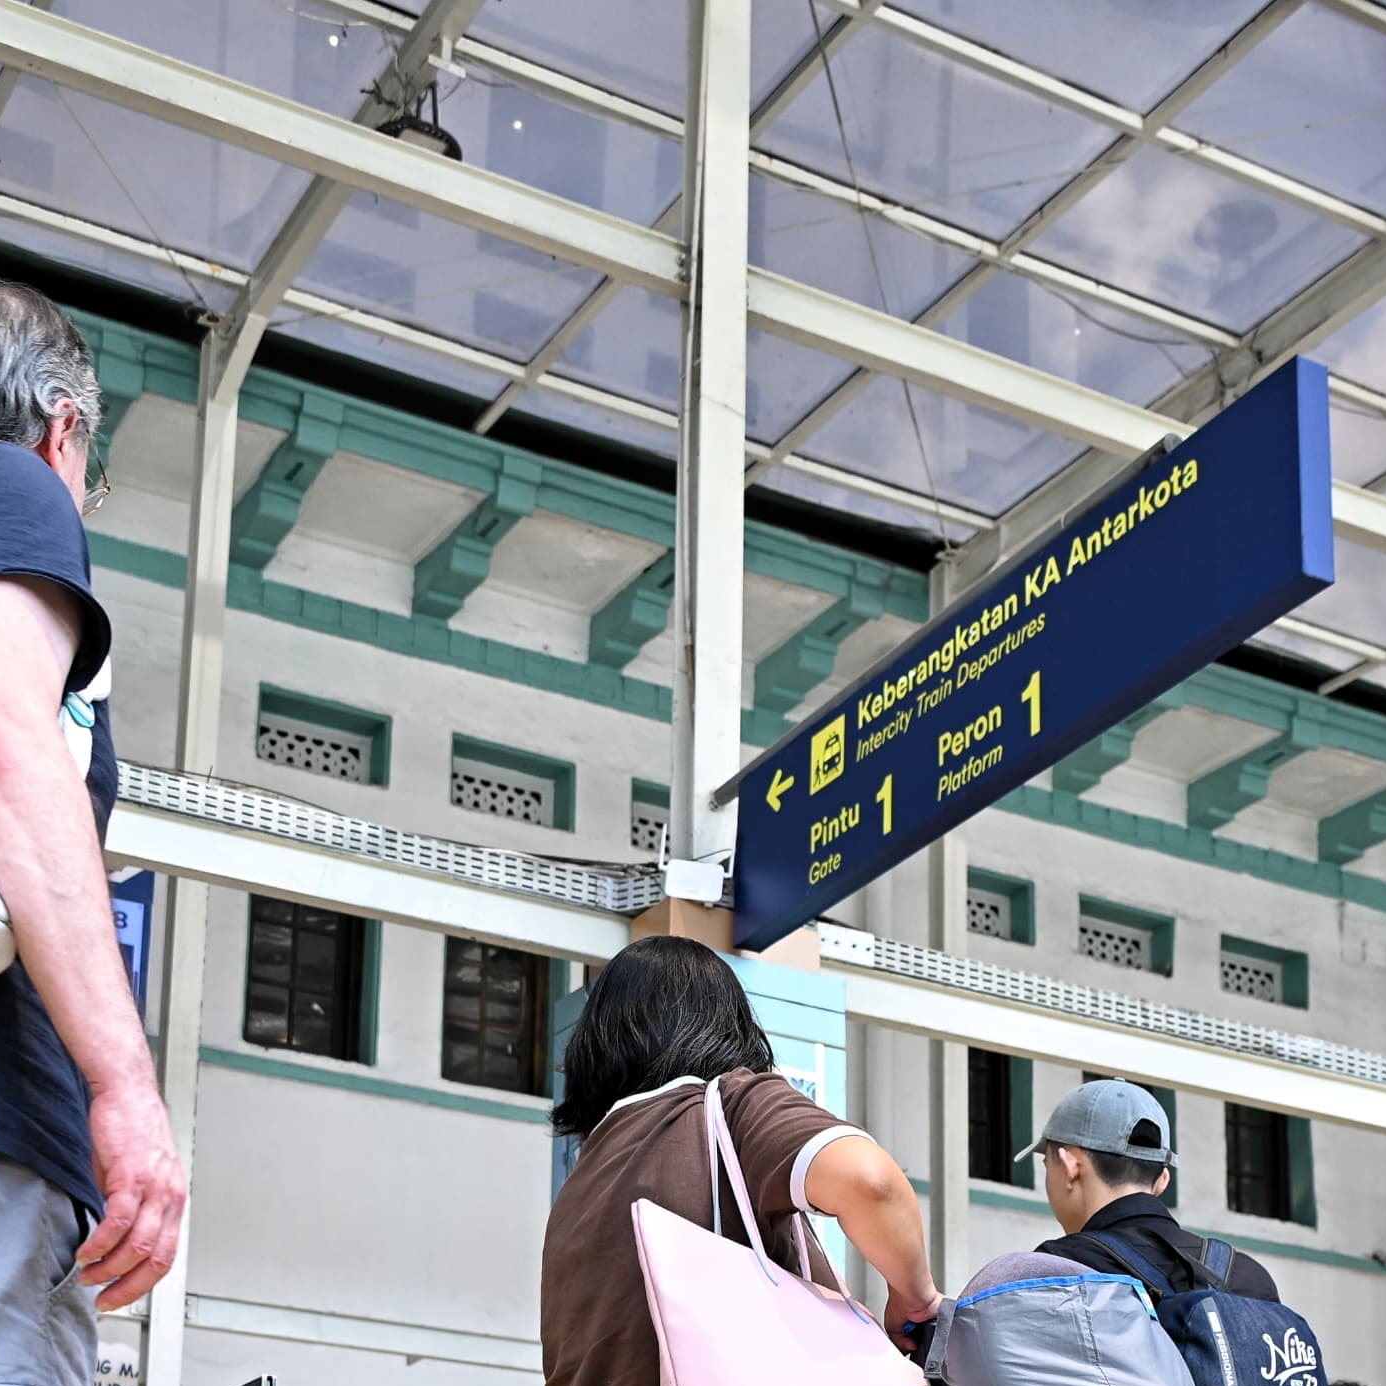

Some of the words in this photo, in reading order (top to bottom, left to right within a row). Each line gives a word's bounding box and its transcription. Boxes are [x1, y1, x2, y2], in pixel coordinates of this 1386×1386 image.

[857, 593, 1018, 730] Keberangkatan
[1024, 555, 1061, 606] KA
[1066, 459, 1198, 577] Antarkota
[856, 707, 913, 763] Intercity
[917, 677, 952, 718] Train
[956, 612, 1046, 690] Departures
[938, 705, 1003, 767] Peron
[1021, 670, 1041, 737] 1
[810, 802, 860, 855] Pintu
[875, 773, 893, 836] 1
[937, 745, 1003, 802] Platform
[808, 853, 842, 885] Gate
[1261, 1327, 1317, 1380] Nike
